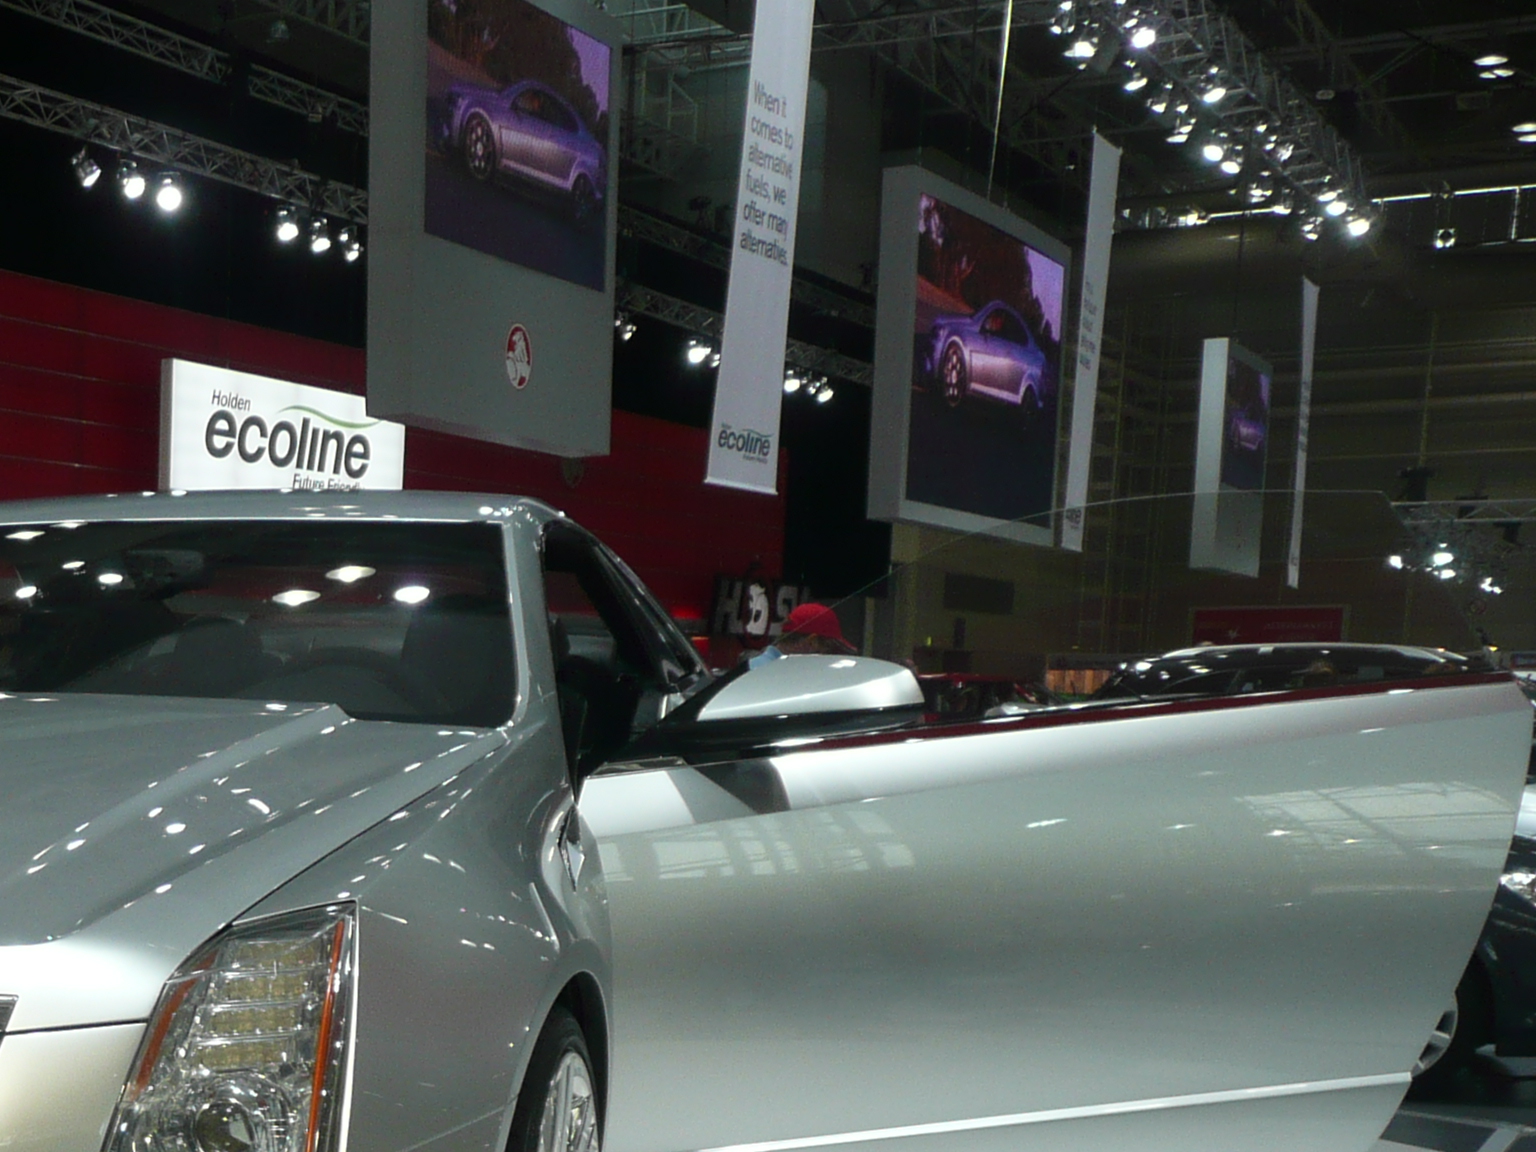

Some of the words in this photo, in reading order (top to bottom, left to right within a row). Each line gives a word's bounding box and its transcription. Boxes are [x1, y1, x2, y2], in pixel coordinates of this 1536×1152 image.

[754, 80, 781, 115] When
[781, 97, 788, 119] it
[751, 115, 783, 146] comes
[785, 126, 794, 151] to
[748, 142, 793, 180] alternative
[745, 168, 771, 203] fuels,
[772, 184, 788, 206] we
[743, 200, 765, 227] offer
[767, 212, 789, 242] many
[211, 389, 252, 412] Holden
[205, 409, 371, 479] ecoline
[718, 430, 770, 456] ecoline
